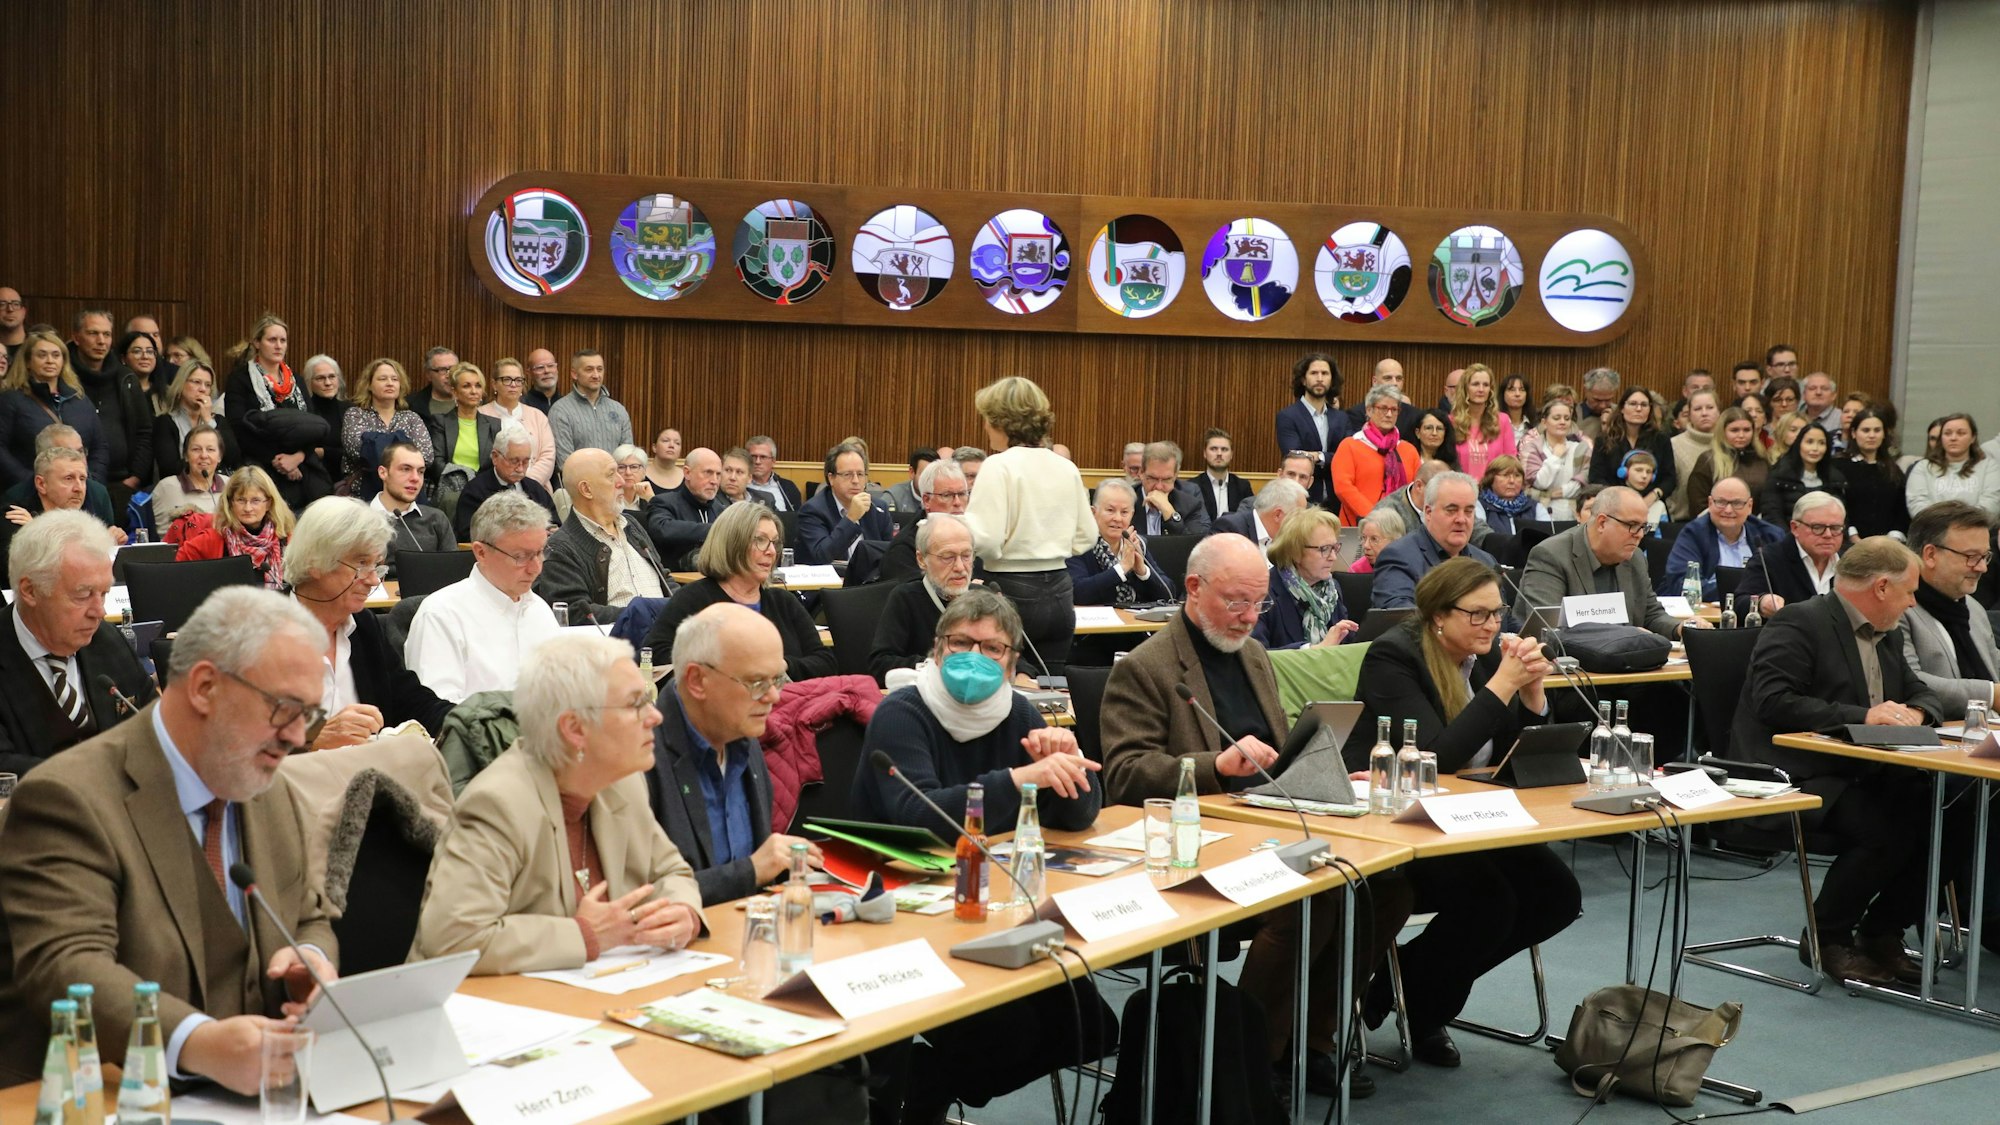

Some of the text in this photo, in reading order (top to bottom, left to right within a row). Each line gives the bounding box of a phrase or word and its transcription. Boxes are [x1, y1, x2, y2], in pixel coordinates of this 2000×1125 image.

[1590, 607, 1617, 616] Schmalt
[1450, 810, 1509, 823] Herr Rickes
[1091, 909, 1117, 922] Herr
[847, 967, 924, 996] Frau Rickes
[514, 1083, 595, 1118] Herr Zorn
